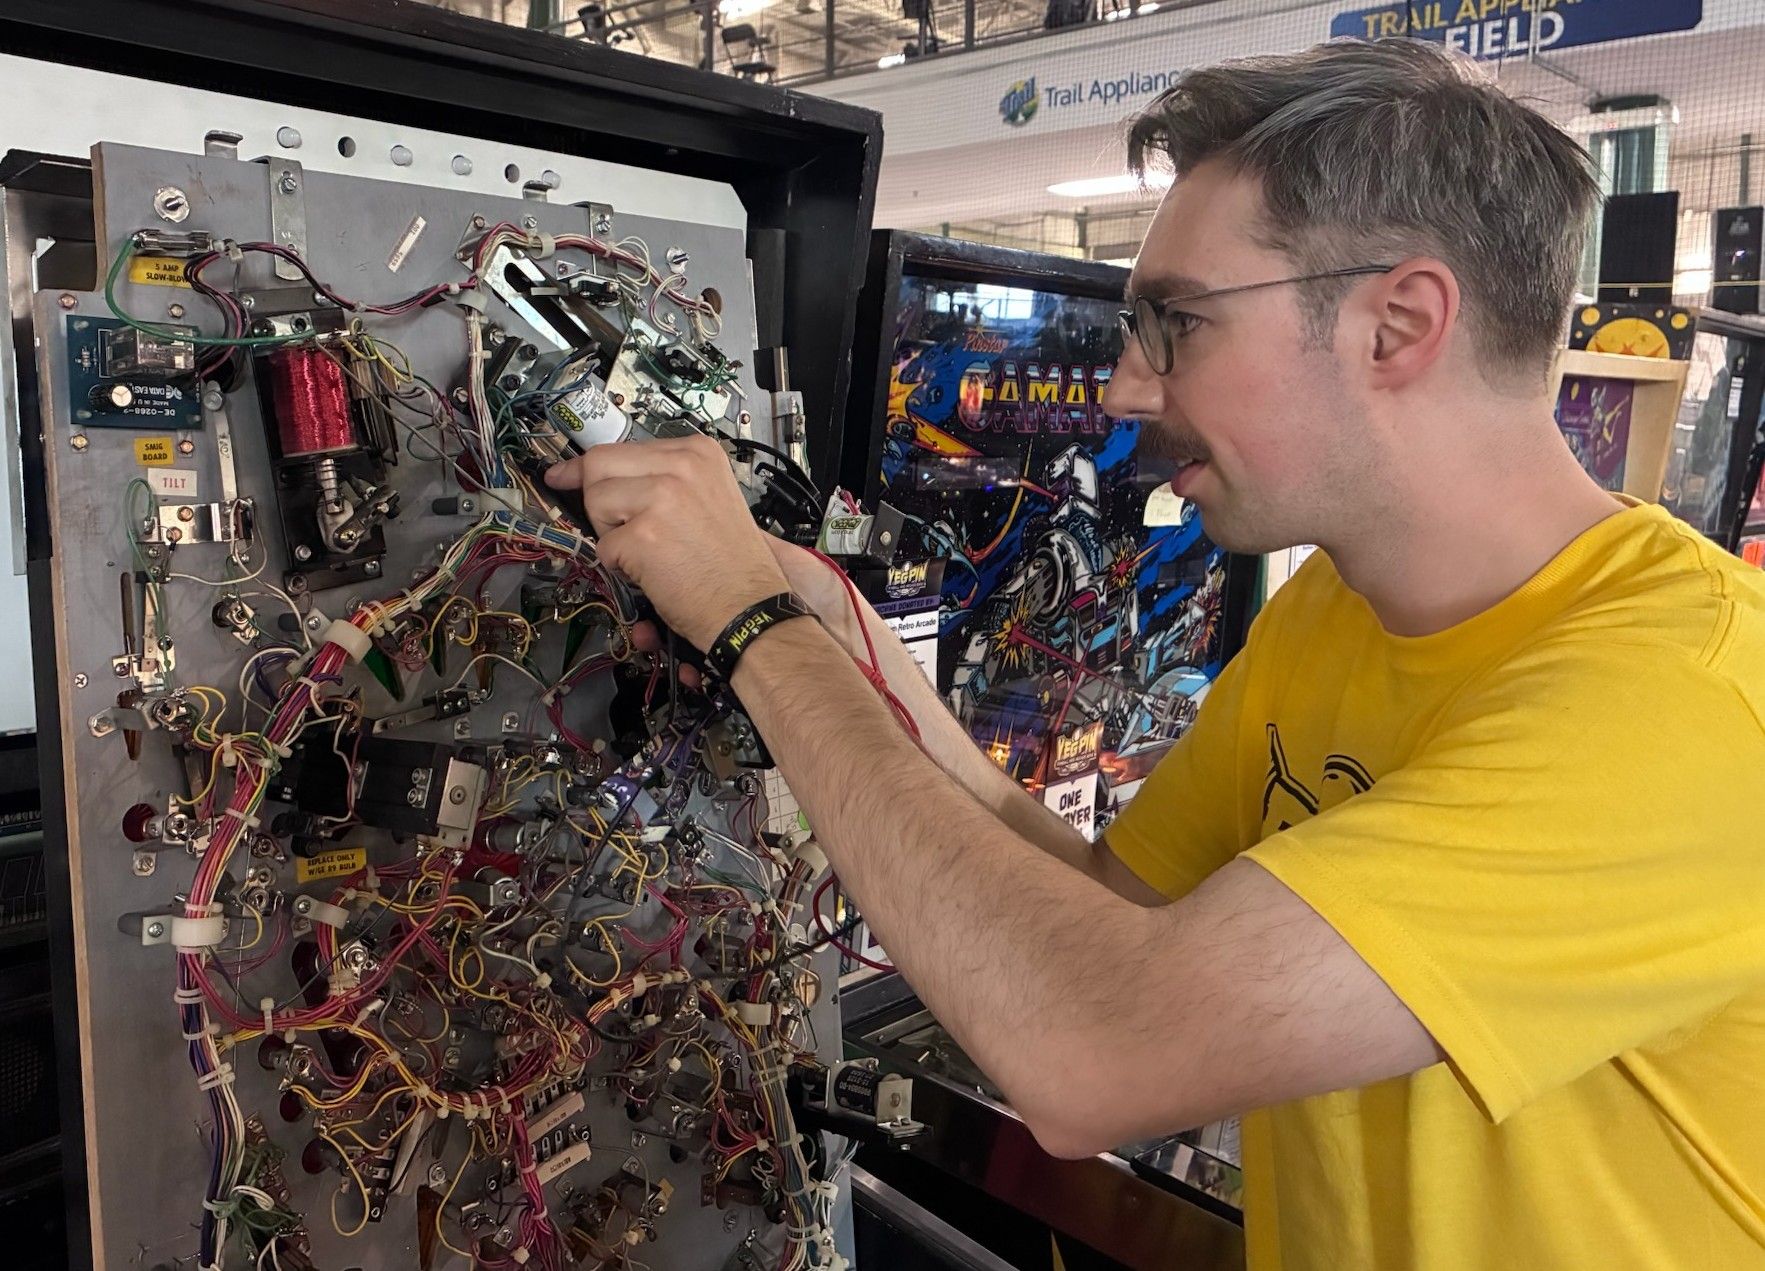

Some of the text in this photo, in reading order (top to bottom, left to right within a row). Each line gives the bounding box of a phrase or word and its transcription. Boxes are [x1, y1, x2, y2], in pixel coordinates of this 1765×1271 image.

[1362, 4, 1448, 38] TRAIL
[1445, 10, 1564, 57] FIELD
[1045, 69, 1179, 108] Trail Applianc
[149, 386, 165, 395] DATA
[142, 453, 168, 461] BOARD
[163, 477, 186, 489] TILT
[888, 560, 929, 585] YEGPIN
[729, 611, 774, 653] YEGPIN
[898, 622, 914, 631] Retro
[916, 618, 937, 628] Arcade
[1057, 727, 1099, 760] YEGPIN
[1060, 789, 1082, 811] ONE
[1063, 805, 1091, 825] AYER
[336, 853, 356, 862] ONLY
[339, 862, 356, 870] BULB
